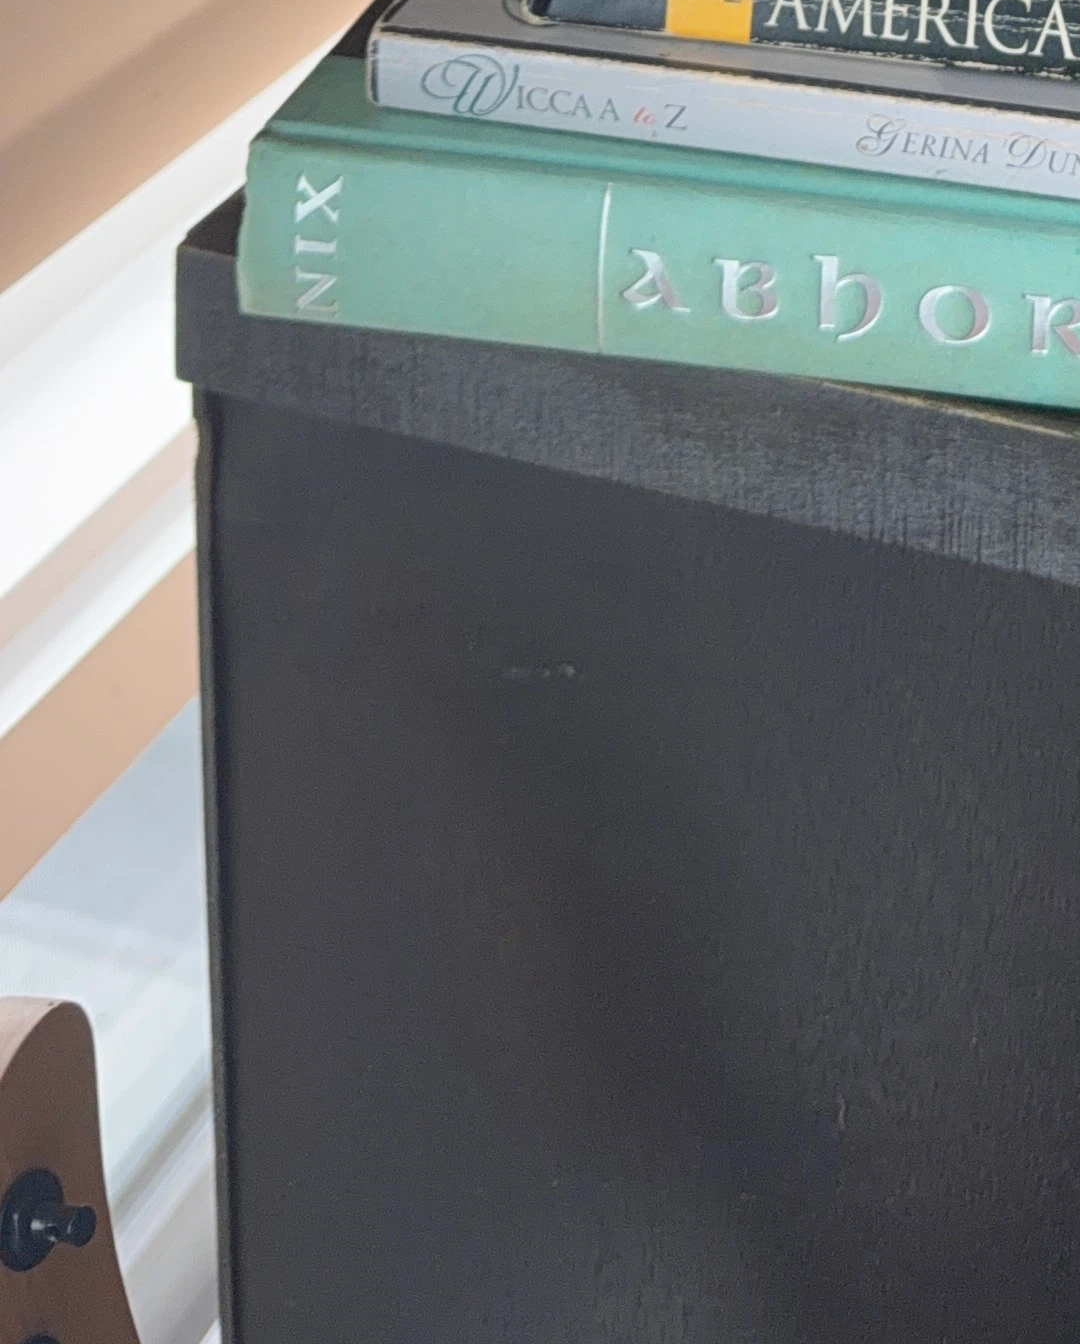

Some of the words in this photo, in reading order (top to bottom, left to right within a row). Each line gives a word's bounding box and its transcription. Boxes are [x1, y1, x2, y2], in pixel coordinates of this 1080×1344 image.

[600, 97, 620, 123] A
[632, 106, 657, 127] to
[663, 104, 688, 131] Z
[295, 172, 344, 316] NIX
